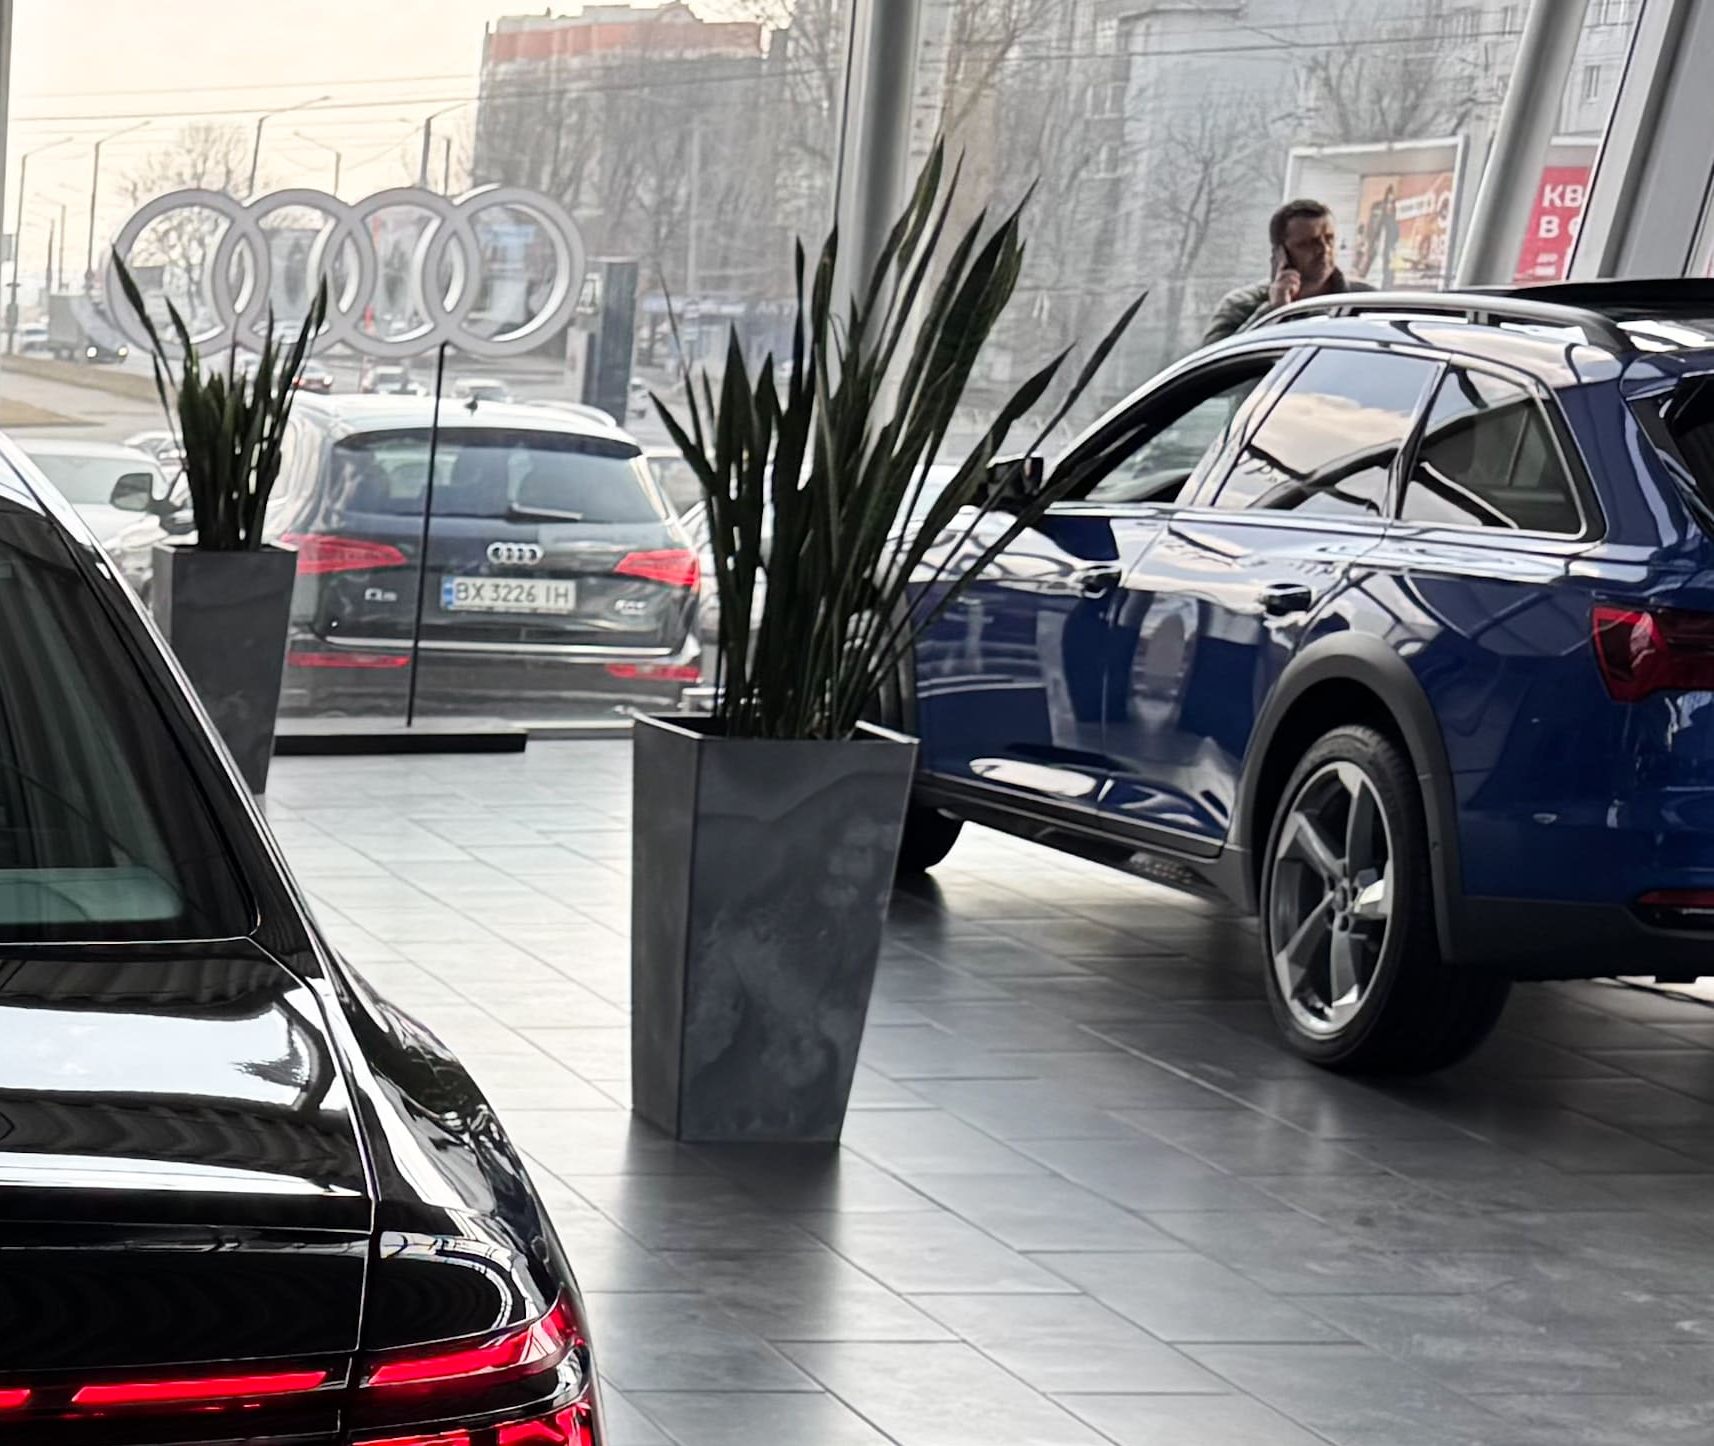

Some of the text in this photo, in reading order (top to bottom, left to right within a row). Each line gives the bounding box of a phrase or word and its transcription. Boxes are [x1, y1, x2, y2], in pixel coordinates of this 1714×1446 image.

[455, 582, 570, 605] BX 3226 IH
